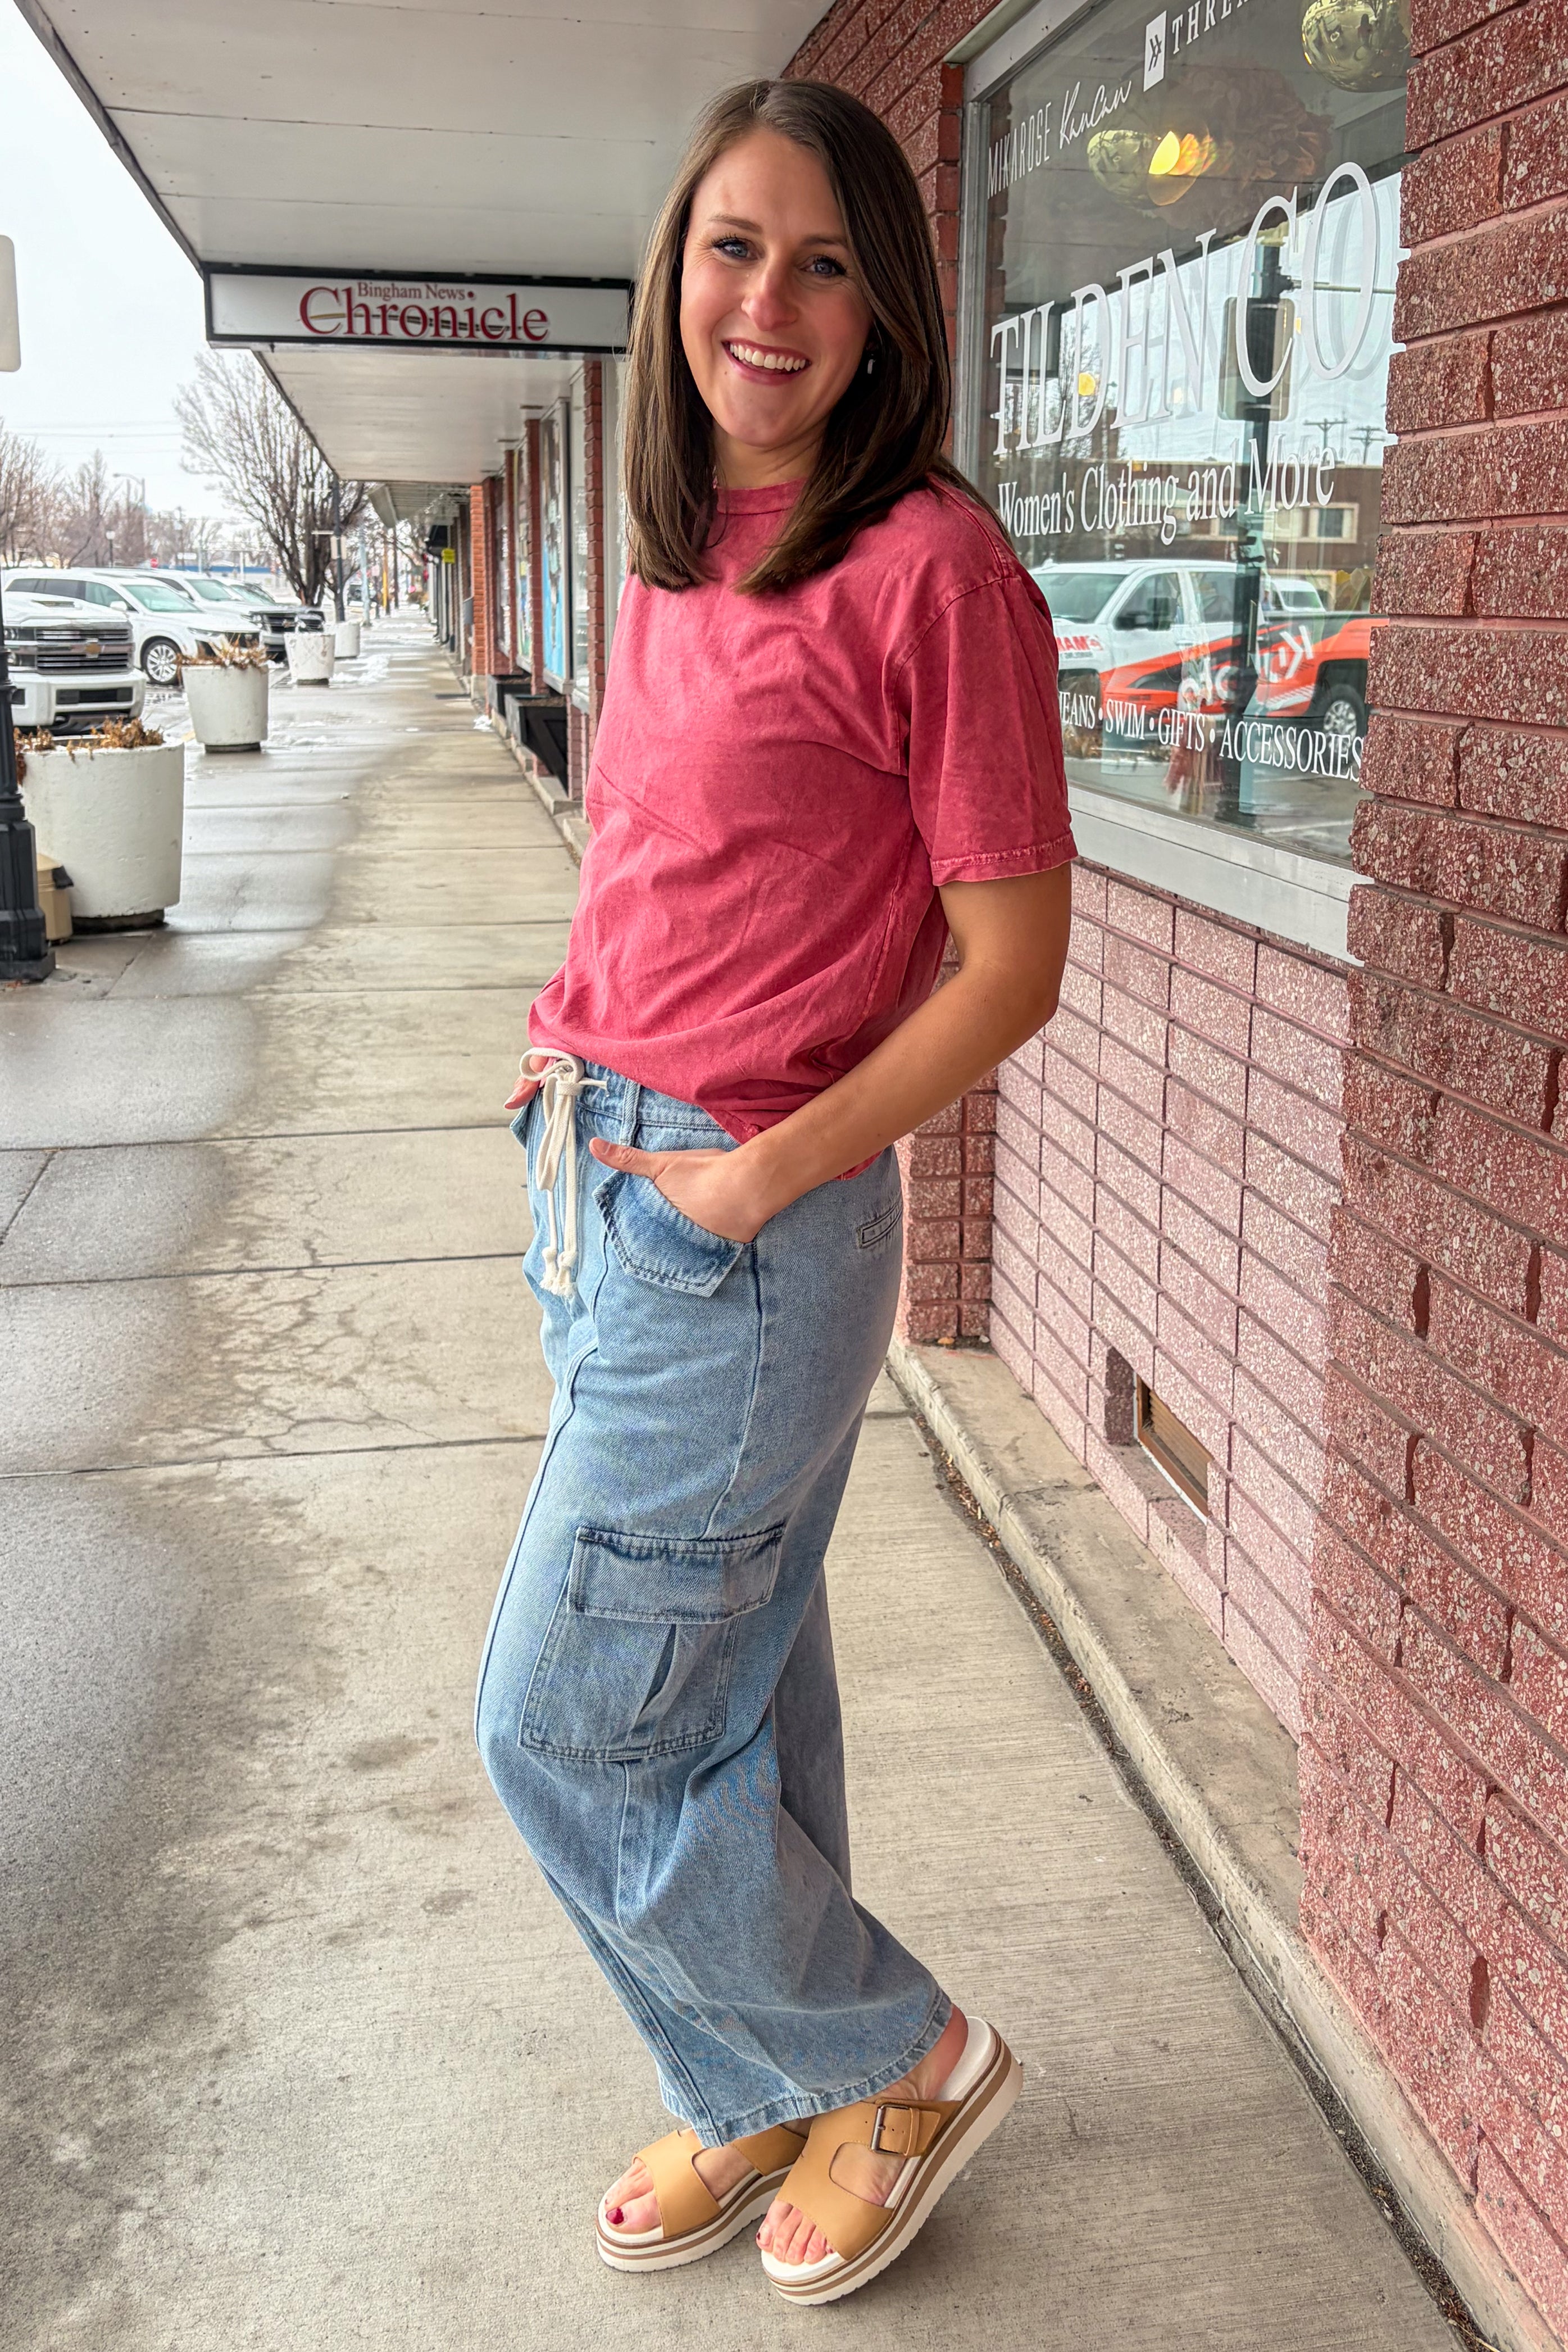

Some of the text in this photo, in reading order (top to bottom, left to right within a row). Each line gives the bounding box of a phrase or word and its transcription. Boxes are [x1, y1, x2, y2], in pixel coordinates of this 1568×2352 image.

[988, 101, 1051, 199] MIKAROSE
[1172, 0, 1248, 55] THRE
[299, 286, 549, 342] Chronicle
[357, 281, 466, 302] Bingham News
[991, 162, 1377, 456] TILDEN CO
[998, 433, 1335, 546] Women's Clothing and More
[1105, 698, 1147, 741] SWIM
[1157, 707, 1206, 752] GIFTS
[1219, 719, 1365, 783] ACCESSORIES
